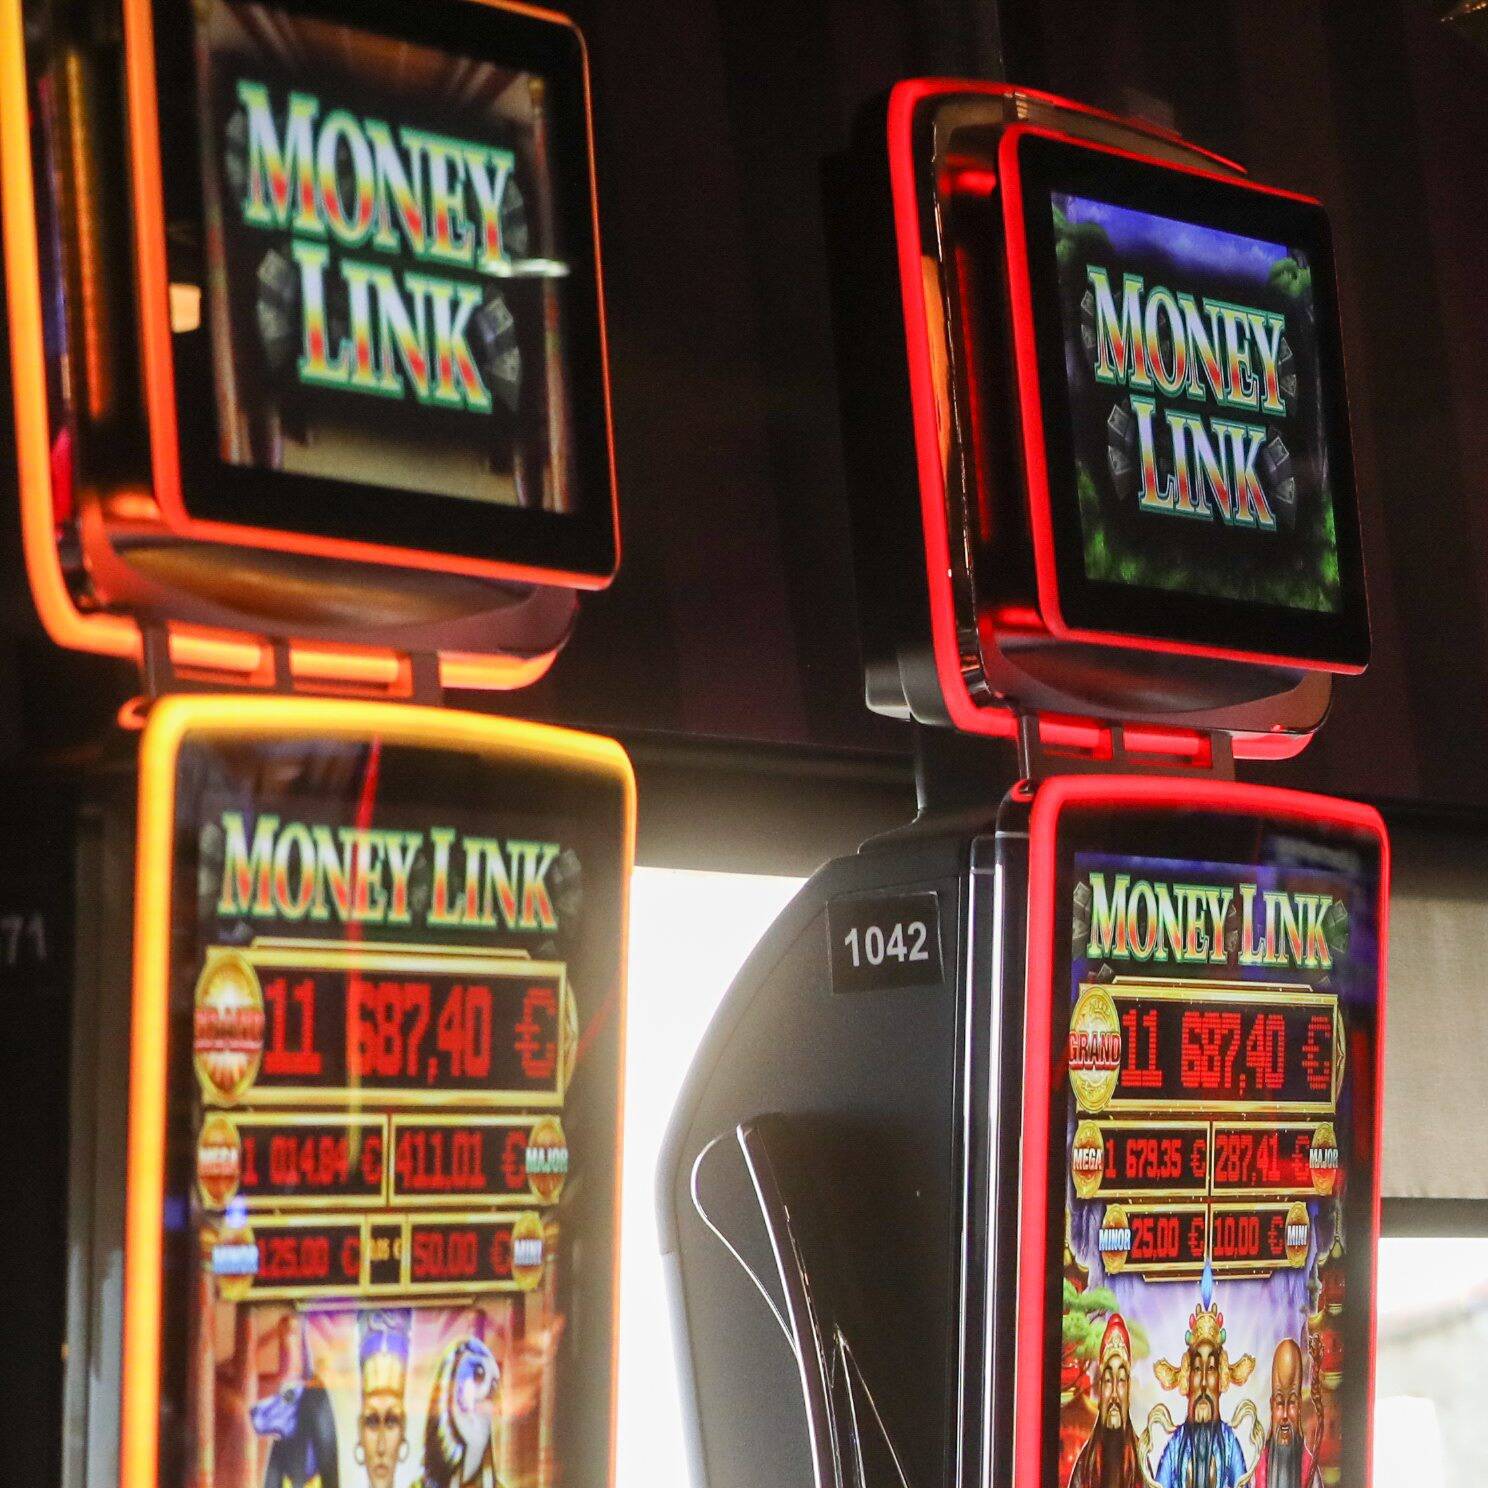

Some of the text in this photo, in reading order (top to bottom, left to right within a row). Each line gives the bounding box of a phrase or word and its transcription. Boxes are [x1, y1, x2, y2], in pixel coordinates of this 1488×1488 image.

[238, 80, 514, 273] MONEY
[293, 239, 491, 413] LINK
[1086, 265, 1285, 416] MONEY
[1131, 395, 1276, 531] LINK
[217, 810, 561, 932] MONEY LINK
[844, 920, 929, 969] 1042
[1087, 872, 1334, 968] MONEY LINK
[1069, 1031, 1121, 1071] GRAND
[1121, 1009, 1333, 1096] 11 687,40 €
[1073, 1147, 1103, 1171] MEGA
[1105, 1138, 1206, 1180] 1 679,35 €
[1215, 1134, 1310, 1185] 287,41 €
[1309, 1147, 1338, 1170] MAJOR
[1099, 1227, 1131, 1251] MINOR
[1131, 1216, 1205, 1260] 25,00 €
[1214, 1216, 1284, 1258] 10,00 €
[1287, 1225, 1307, 1247] MINI
